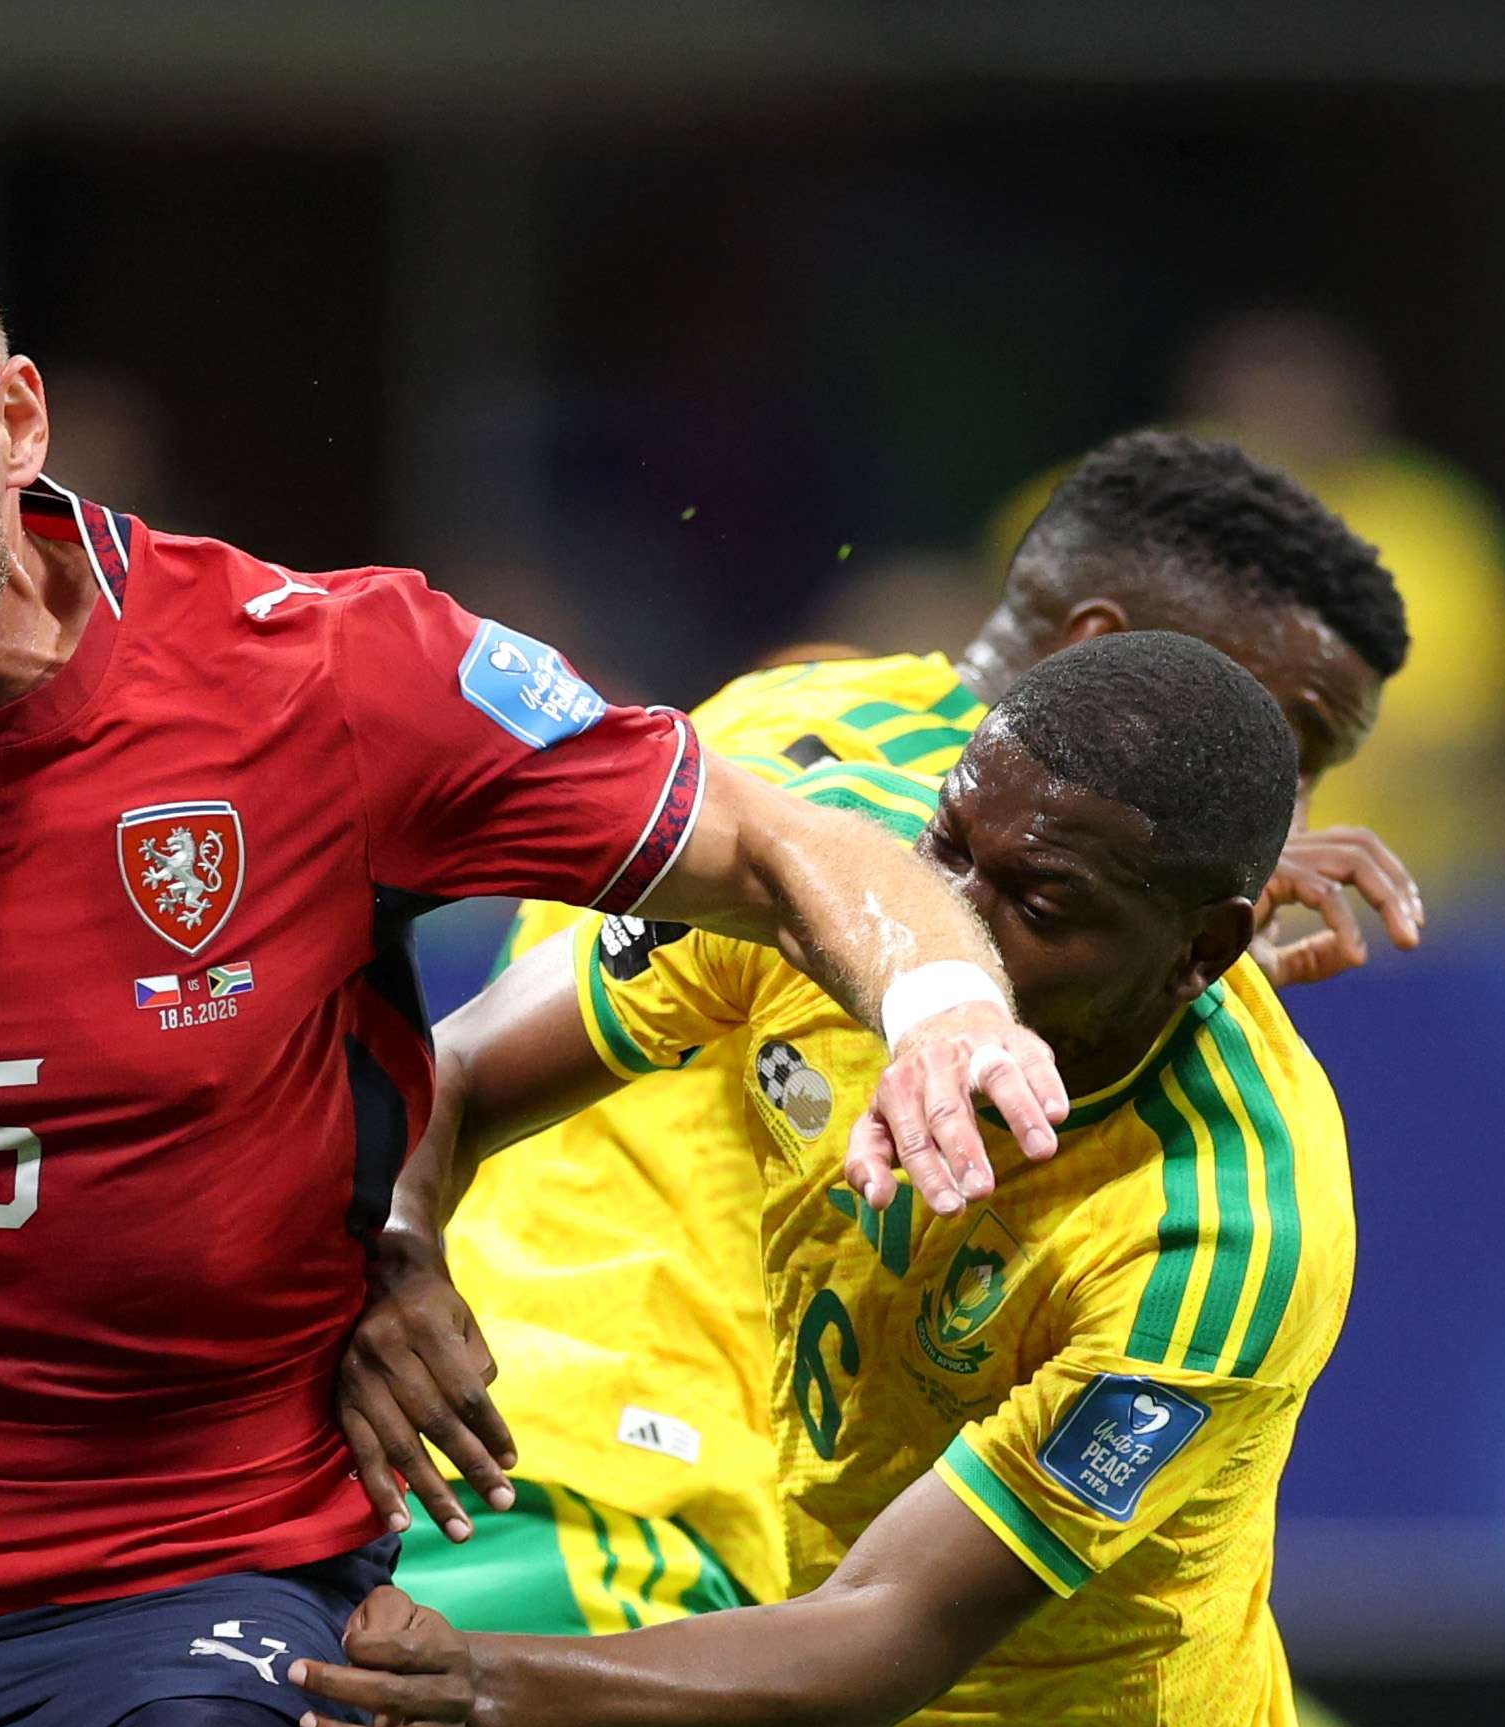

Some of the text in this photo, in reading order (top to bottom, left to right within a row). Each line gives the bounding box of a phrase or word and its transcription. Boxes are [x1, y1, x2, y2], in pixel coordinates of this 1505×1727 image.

[159, 998, 238, 1030] 18.6.2026
[917, 1320, 972, 1372] SOUTH AFRICA
[793, 1288, 860, 1461] 6
[1093, 1419, 1134, 1454] Unite
[1080, 1440, 1136, 1487] PEACE
[1080, 1469, 1110, 1496] FIFA
